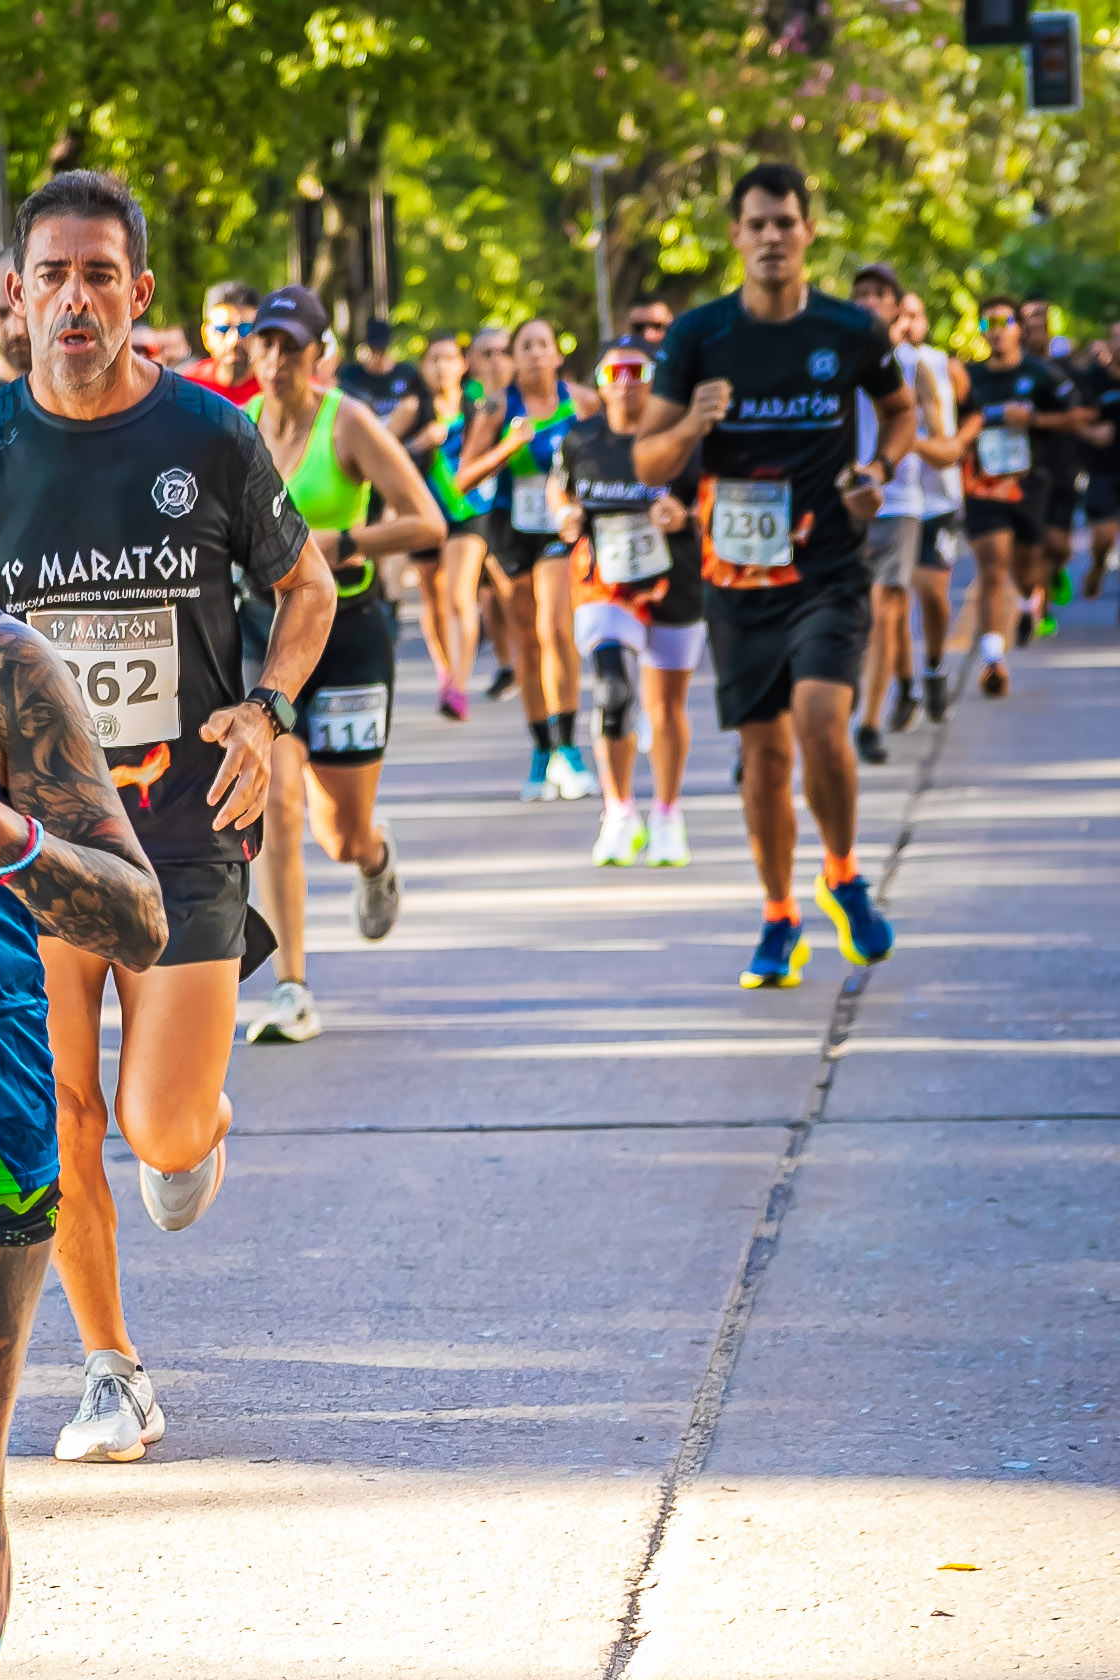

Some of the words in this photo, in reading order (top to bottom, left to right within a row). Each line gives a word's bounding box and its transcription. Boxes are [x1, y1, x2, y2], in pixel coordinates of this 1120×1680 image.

[723, 511, 776, 539] 230
[38, 534, 198, 589] MARATÓN
[46, 590, 101, 604] BOMBEROS
[103, 588, 168, 600] VOLUNTARIOS
[70, 615, 157, 640] MARATÓN
[320, 720, 378, 752] 114
